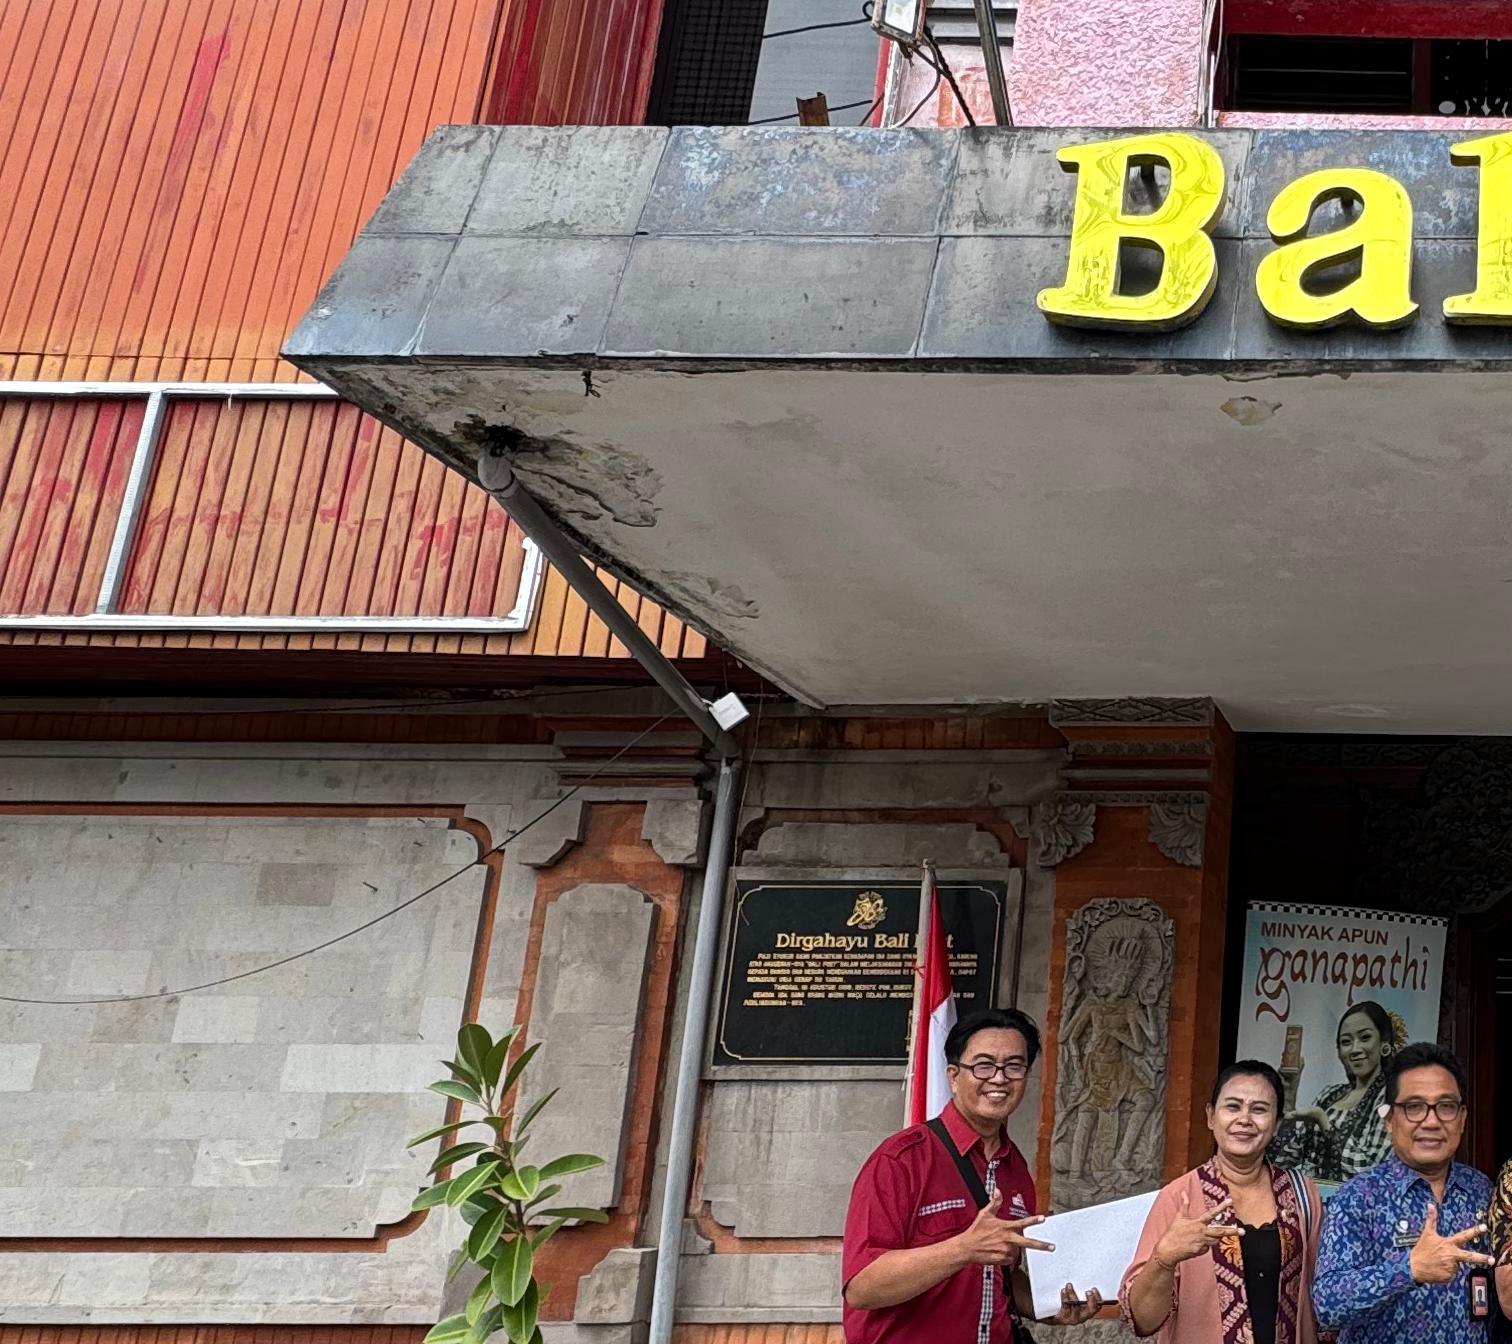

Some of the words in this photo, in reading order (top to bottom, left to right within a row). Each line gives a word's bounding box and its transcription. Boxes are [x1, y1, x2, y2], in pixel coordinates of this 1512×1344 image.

[775, 932, 869, 952] Dirgahayu
[874, 932, 910, 949] Bali
[1260, 921, 1335, 942] MINYAK
[1338, 927, 1389, 947] APUN
